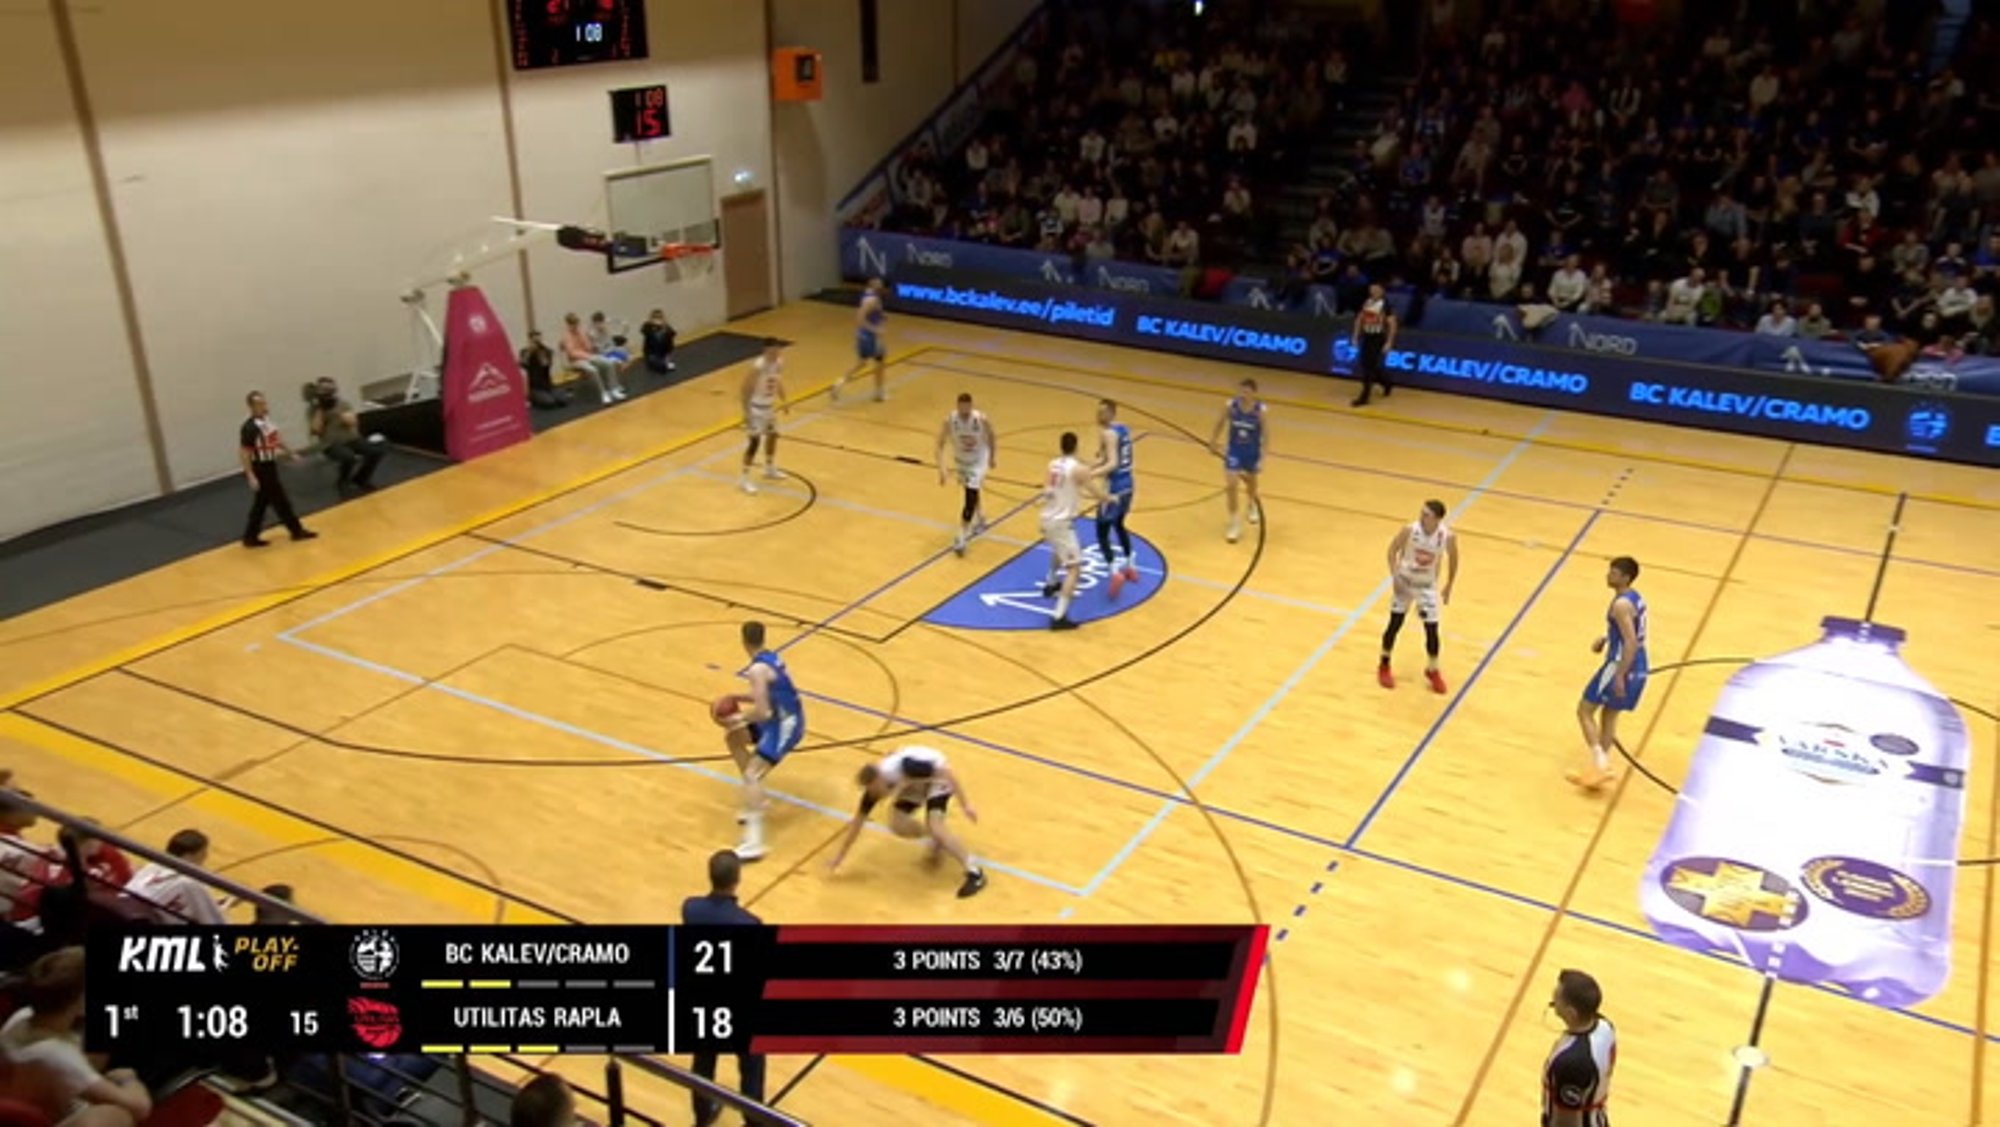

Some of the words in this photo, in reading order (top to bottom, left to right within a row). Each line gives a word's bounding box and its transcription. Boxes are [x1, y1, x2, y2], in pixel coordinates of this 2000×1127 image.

[896, 283, 1115, 327] www.bckalev.ee/piletid
[1137, 315, 1163, 334] BC
[1164, 319, 1308, 356] KALEV/CRAMO
[1568, 321, 1638, 356] NORD
[1384, 350, 1416, 370] BC
[1418, 353, 1589, 394] KALEV/CRAMO
[1629, 381, 1664, 404] BC
[1668, 386, 1871, 431] KALEV/CRAMO
